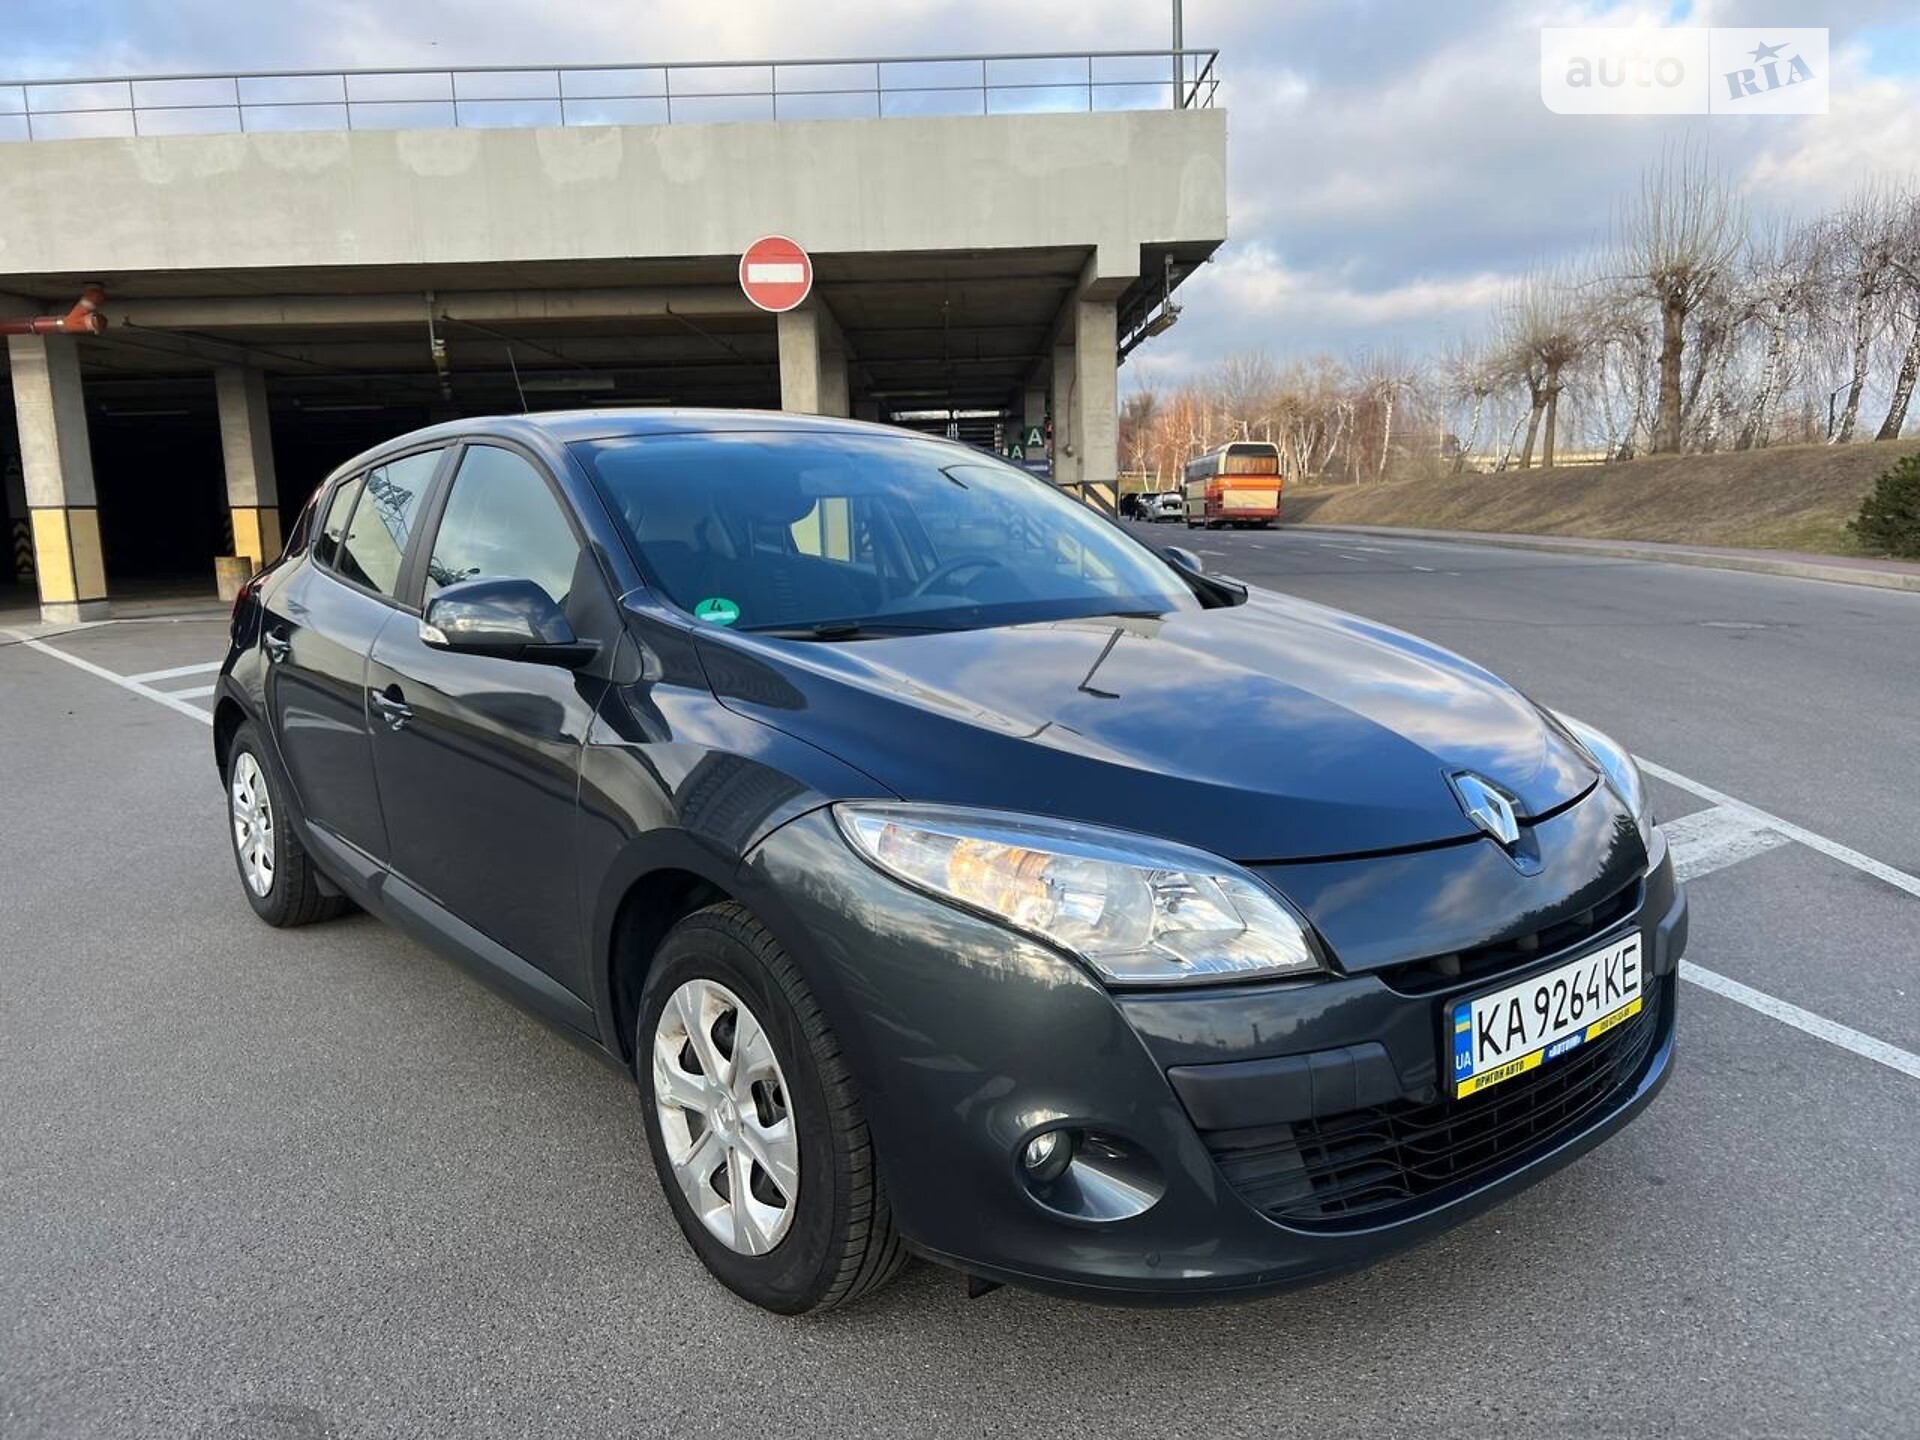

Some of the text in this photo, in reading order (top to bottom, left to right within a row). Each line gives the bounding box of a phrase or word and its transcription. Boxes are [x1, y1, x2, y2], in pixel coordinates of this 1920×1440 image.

[1028, 428, 1043, 445] A
[1011, 445, 1024, 459] A
[710, 599, 722, 612] 4
[1456, 1051, 1472, 1070] UA
[1475, 1059, 1525, 1088] ПРИГОН АВТО
